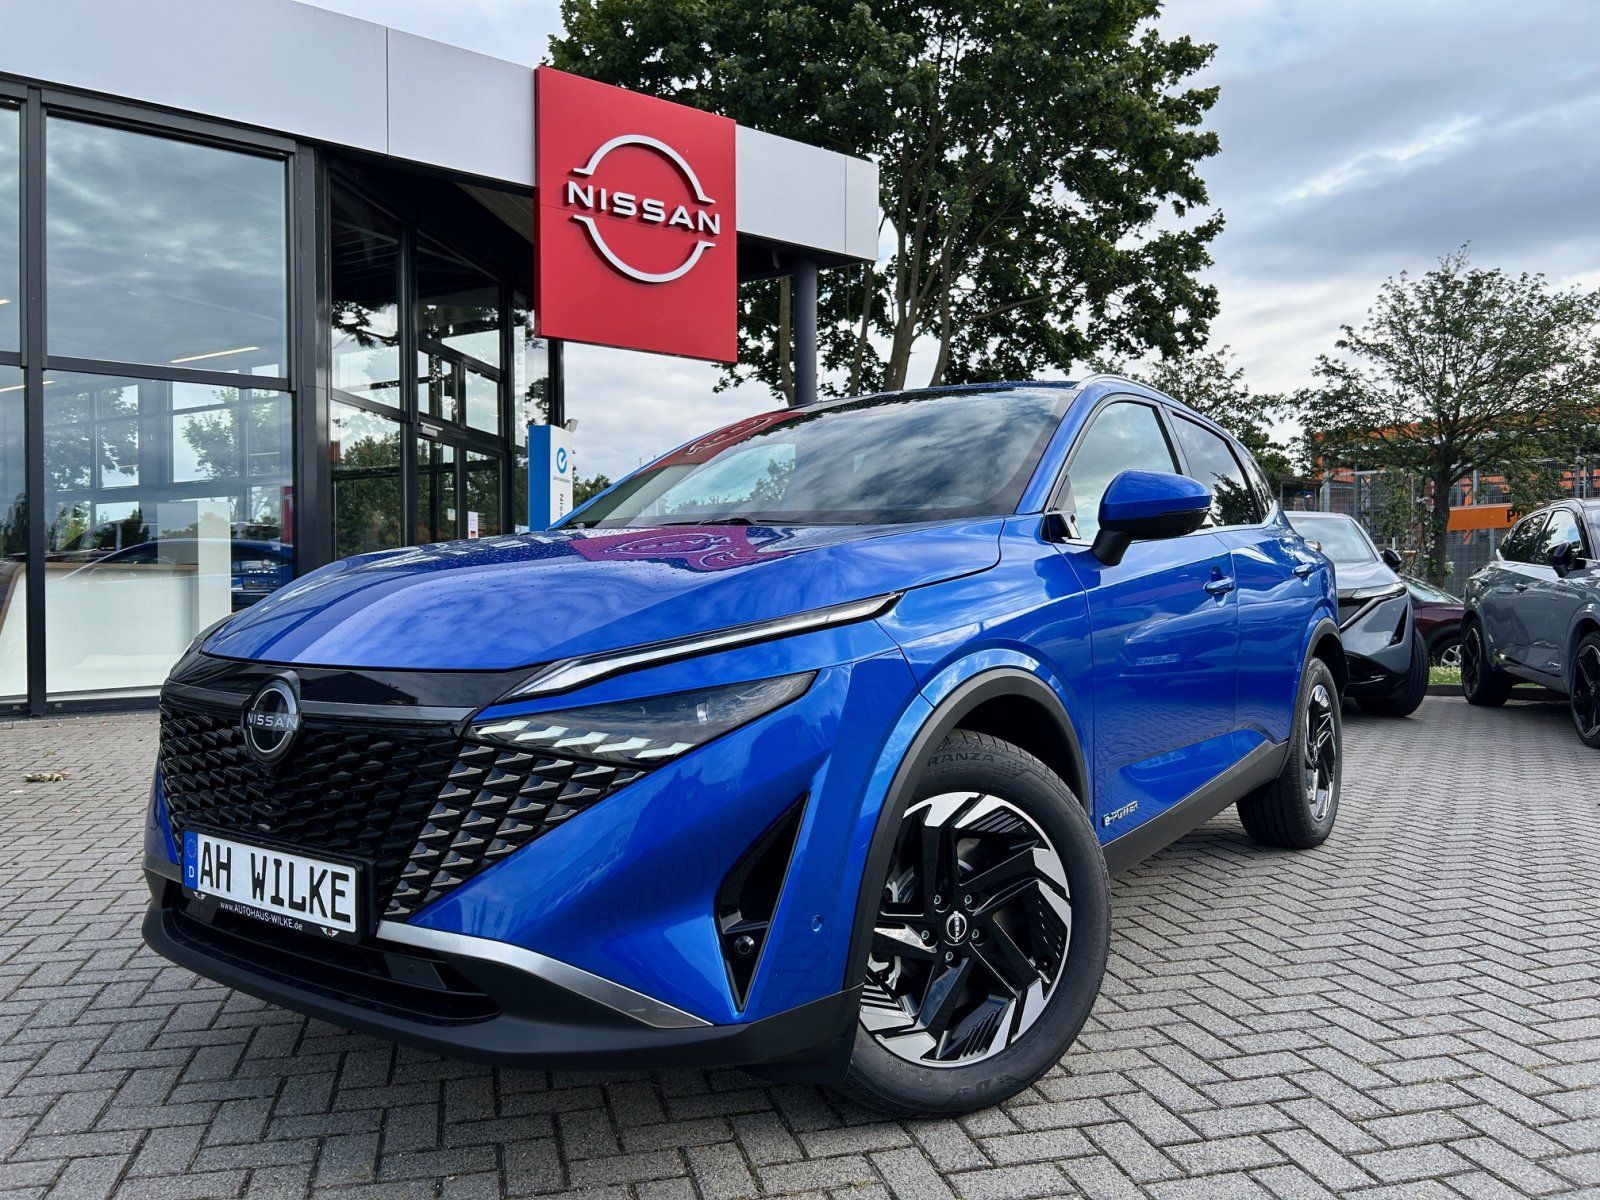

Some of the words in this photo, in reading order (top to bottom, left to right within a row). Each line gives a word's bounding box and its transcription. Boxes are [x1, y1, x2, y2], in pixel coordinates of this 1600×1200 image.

[566, 180, 720, 235] NISSAN
[247, 712, 299, 729] NISSAN
[188, 865, 195, 878] D
[200, 841, 232, 892] AH
[250, 852, 351, 923] WILKE
[219, 901, 303, 931] www.AUTOHAUS-WILKE.de
